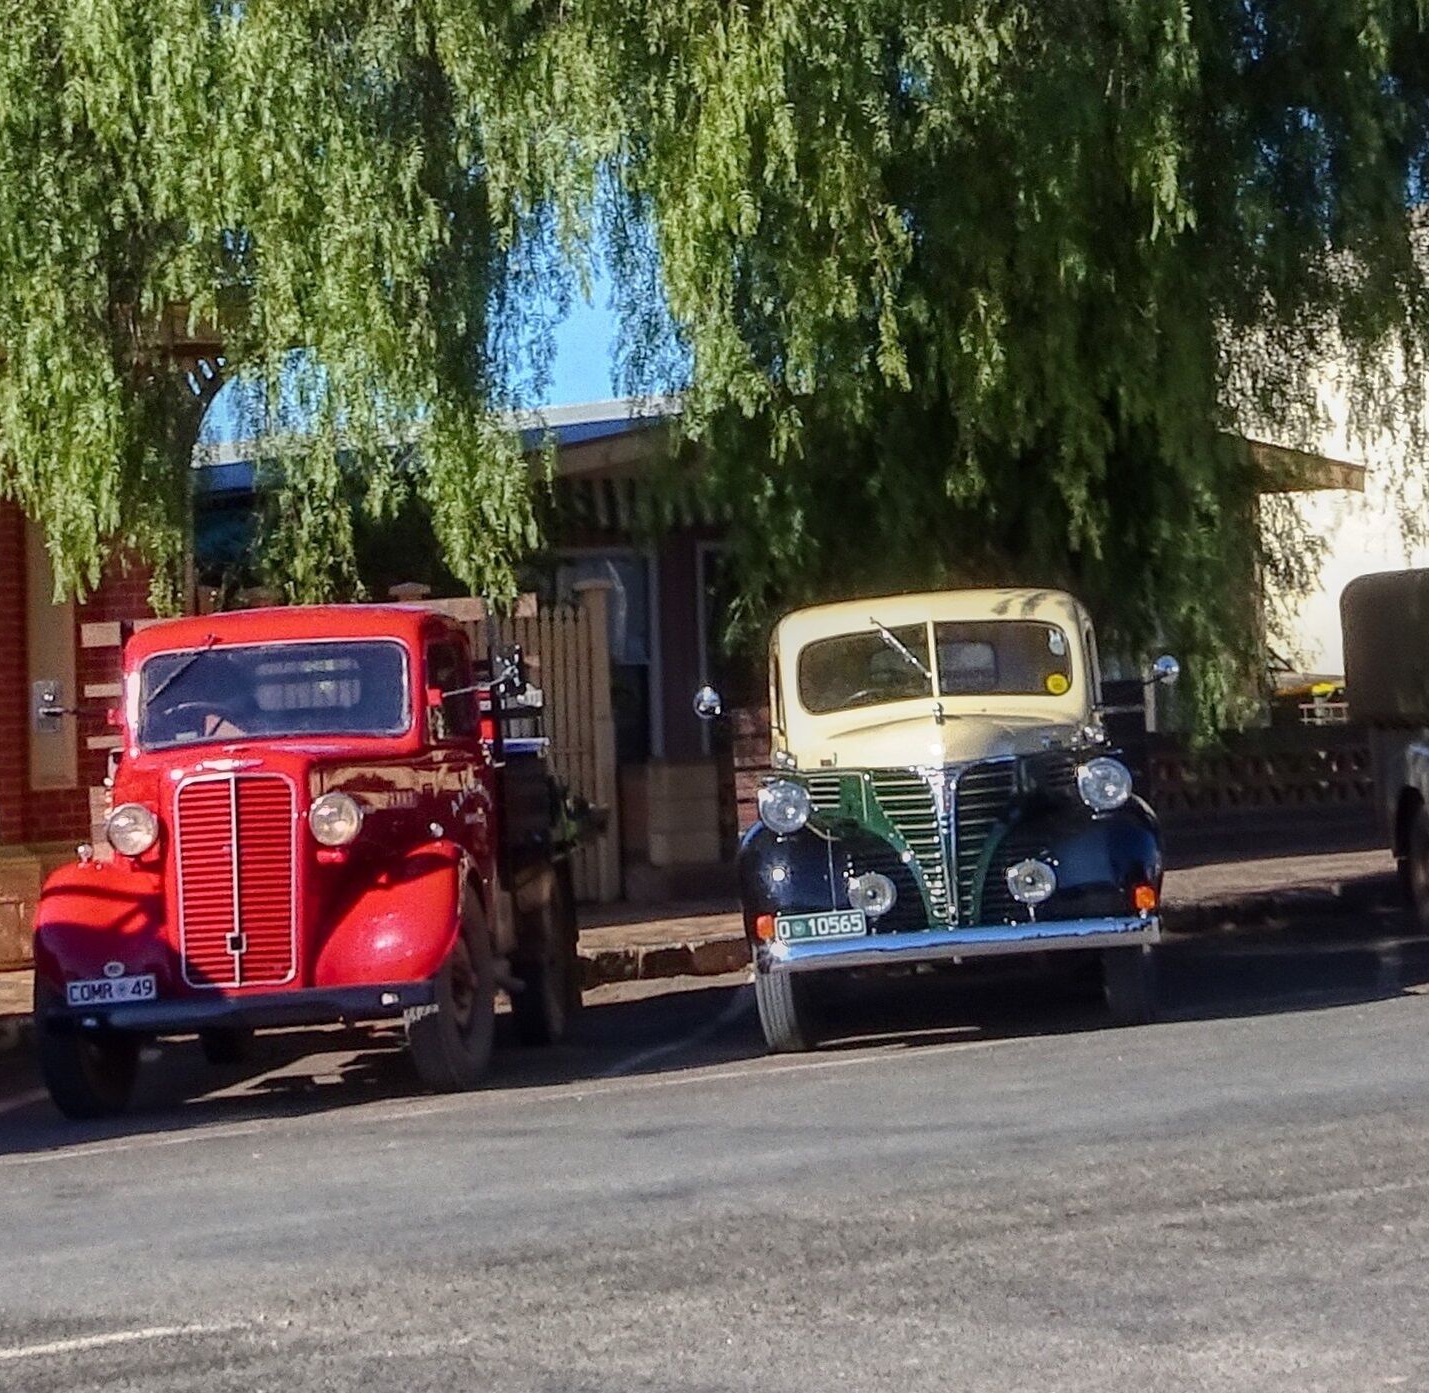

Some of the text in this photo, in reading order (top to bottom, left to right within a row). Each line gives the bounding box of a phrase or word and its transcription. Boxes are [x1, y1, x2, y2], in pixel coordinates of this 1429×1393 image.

[808, 914, 862, 935] 10565
[69, 979, 153, 1002] COMR 49
